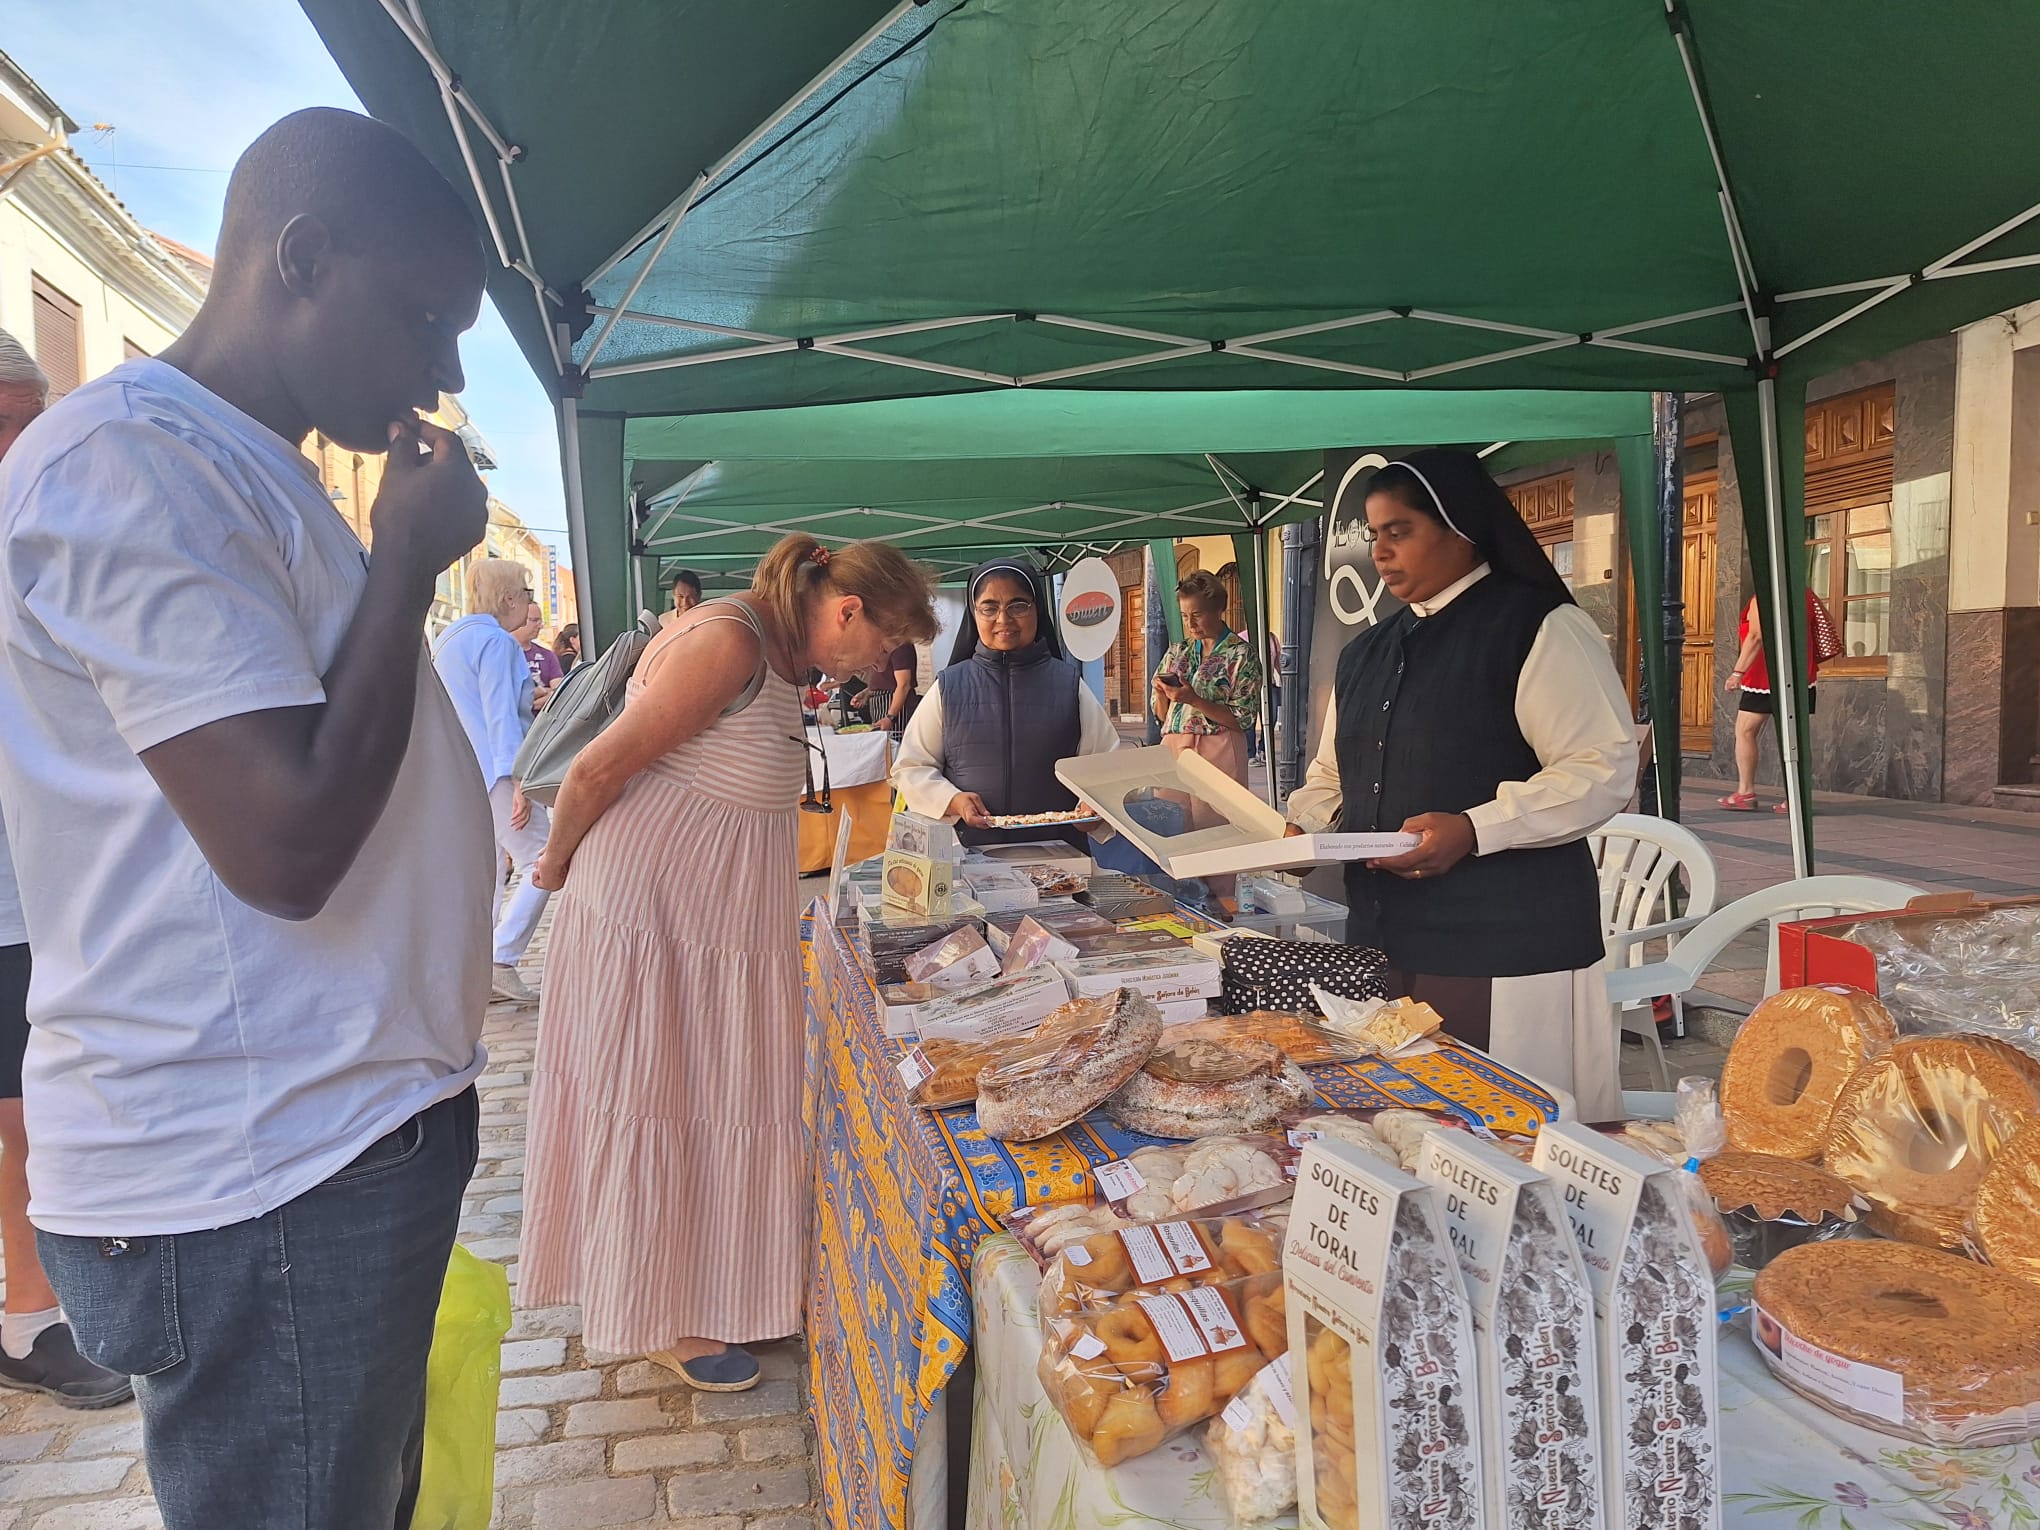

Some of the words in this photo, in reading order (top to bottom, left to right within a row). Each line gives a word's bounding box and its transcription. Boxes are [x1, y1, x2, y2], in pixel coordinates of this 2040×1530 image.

[1310, 1162, 1379, 1216] SOLETES
[1430, 1153, 1499, 1206] SOLETES
[1548, 1143, 1622, 1196] SOLETES
[1328, 1203, 1350, 1231] DE
[1447, 1193, 1470, 1221] DE
[1564, 1183, 1588, 1211] DE
[1163, 1225, 1181, 1254] Rosquillas
[1309, 1222, 1359, 1271] TORAL
[1449, 1226, 1477, 1260] RAL
[1323, 1260, 1337, 1276] del
[1337, 1264, 1375, 1295] Convento
[1414, 1331, 1440, 1378] Belén
[1534, 1325, 1560, 1369] Belén
[1654, 1315, 1679, 1356] Belén
[1538, 1370, 1555, 1389] de
[1655, 1358, 1673, 1376] de
[1419, 1380, 1435, 1400] de
[1657, 1380, 1681, 1432] Señora
[1421, 1404, 1446, 1456] Señora
[1539, 1393, 1564, 1444] Señora
[1541, 1448, 1566, 1506] Nuestra
[1659, 1436, 1684, 1494] Nuestra
[1423, 1459, 1449, 1517] Nuestra
